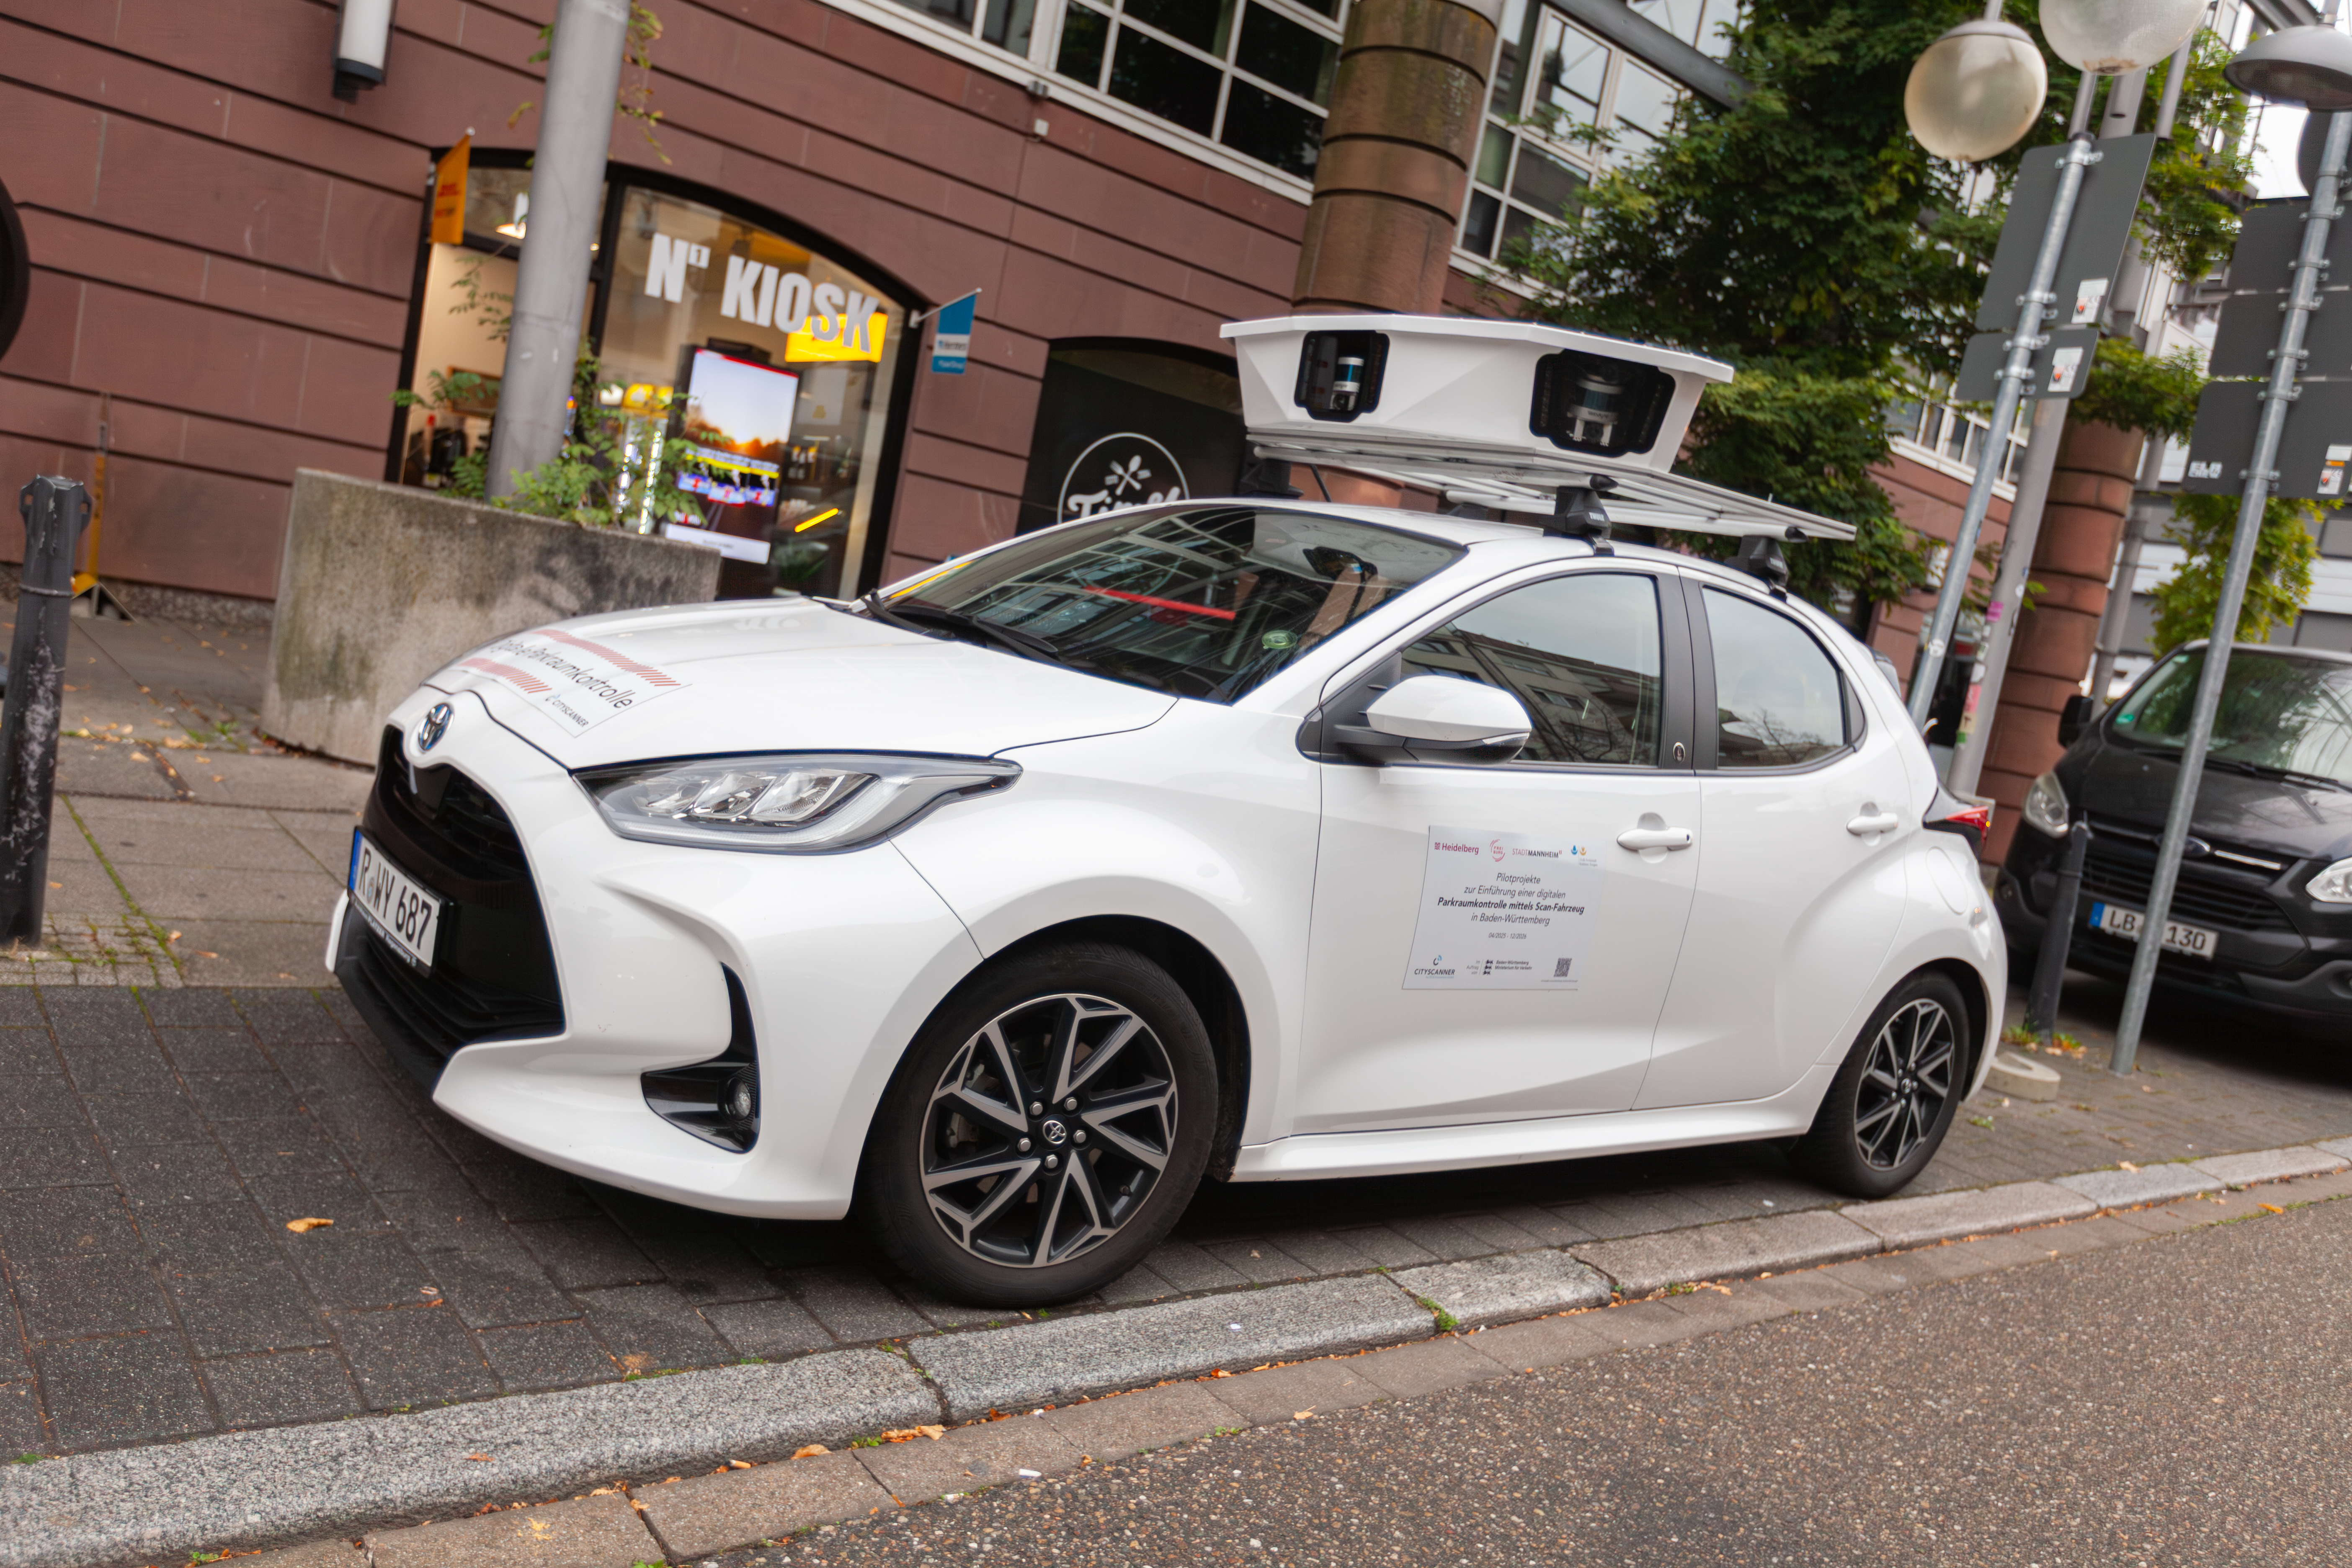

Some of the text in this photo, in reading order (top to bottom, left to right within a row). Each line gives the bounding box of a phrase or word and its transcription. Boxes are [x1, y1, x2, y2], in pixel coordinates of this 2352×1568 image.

[720, 254, 879, 354] KIOSK
[552, 700, 589, 727] CITYSCANNER
[1442, 843, 1479, 855] Heidelberg
[1496, 872, 1541, 885] Pilotprojekte
[359, 847, 432, 950] R WY 687
[1478, 885, 1516, 898] Einführung
[1518, 888, 1535, 897] einer
[1537, 888, 1566, 900] digitalen
[1437, 897, 1585, 915] Parkraumkontrolle mittels Scan-Fahrzeug
[1471, 912, 1550, 927] in Baden-Württemberg
[2109, 910, 2206, 951] LB 130
